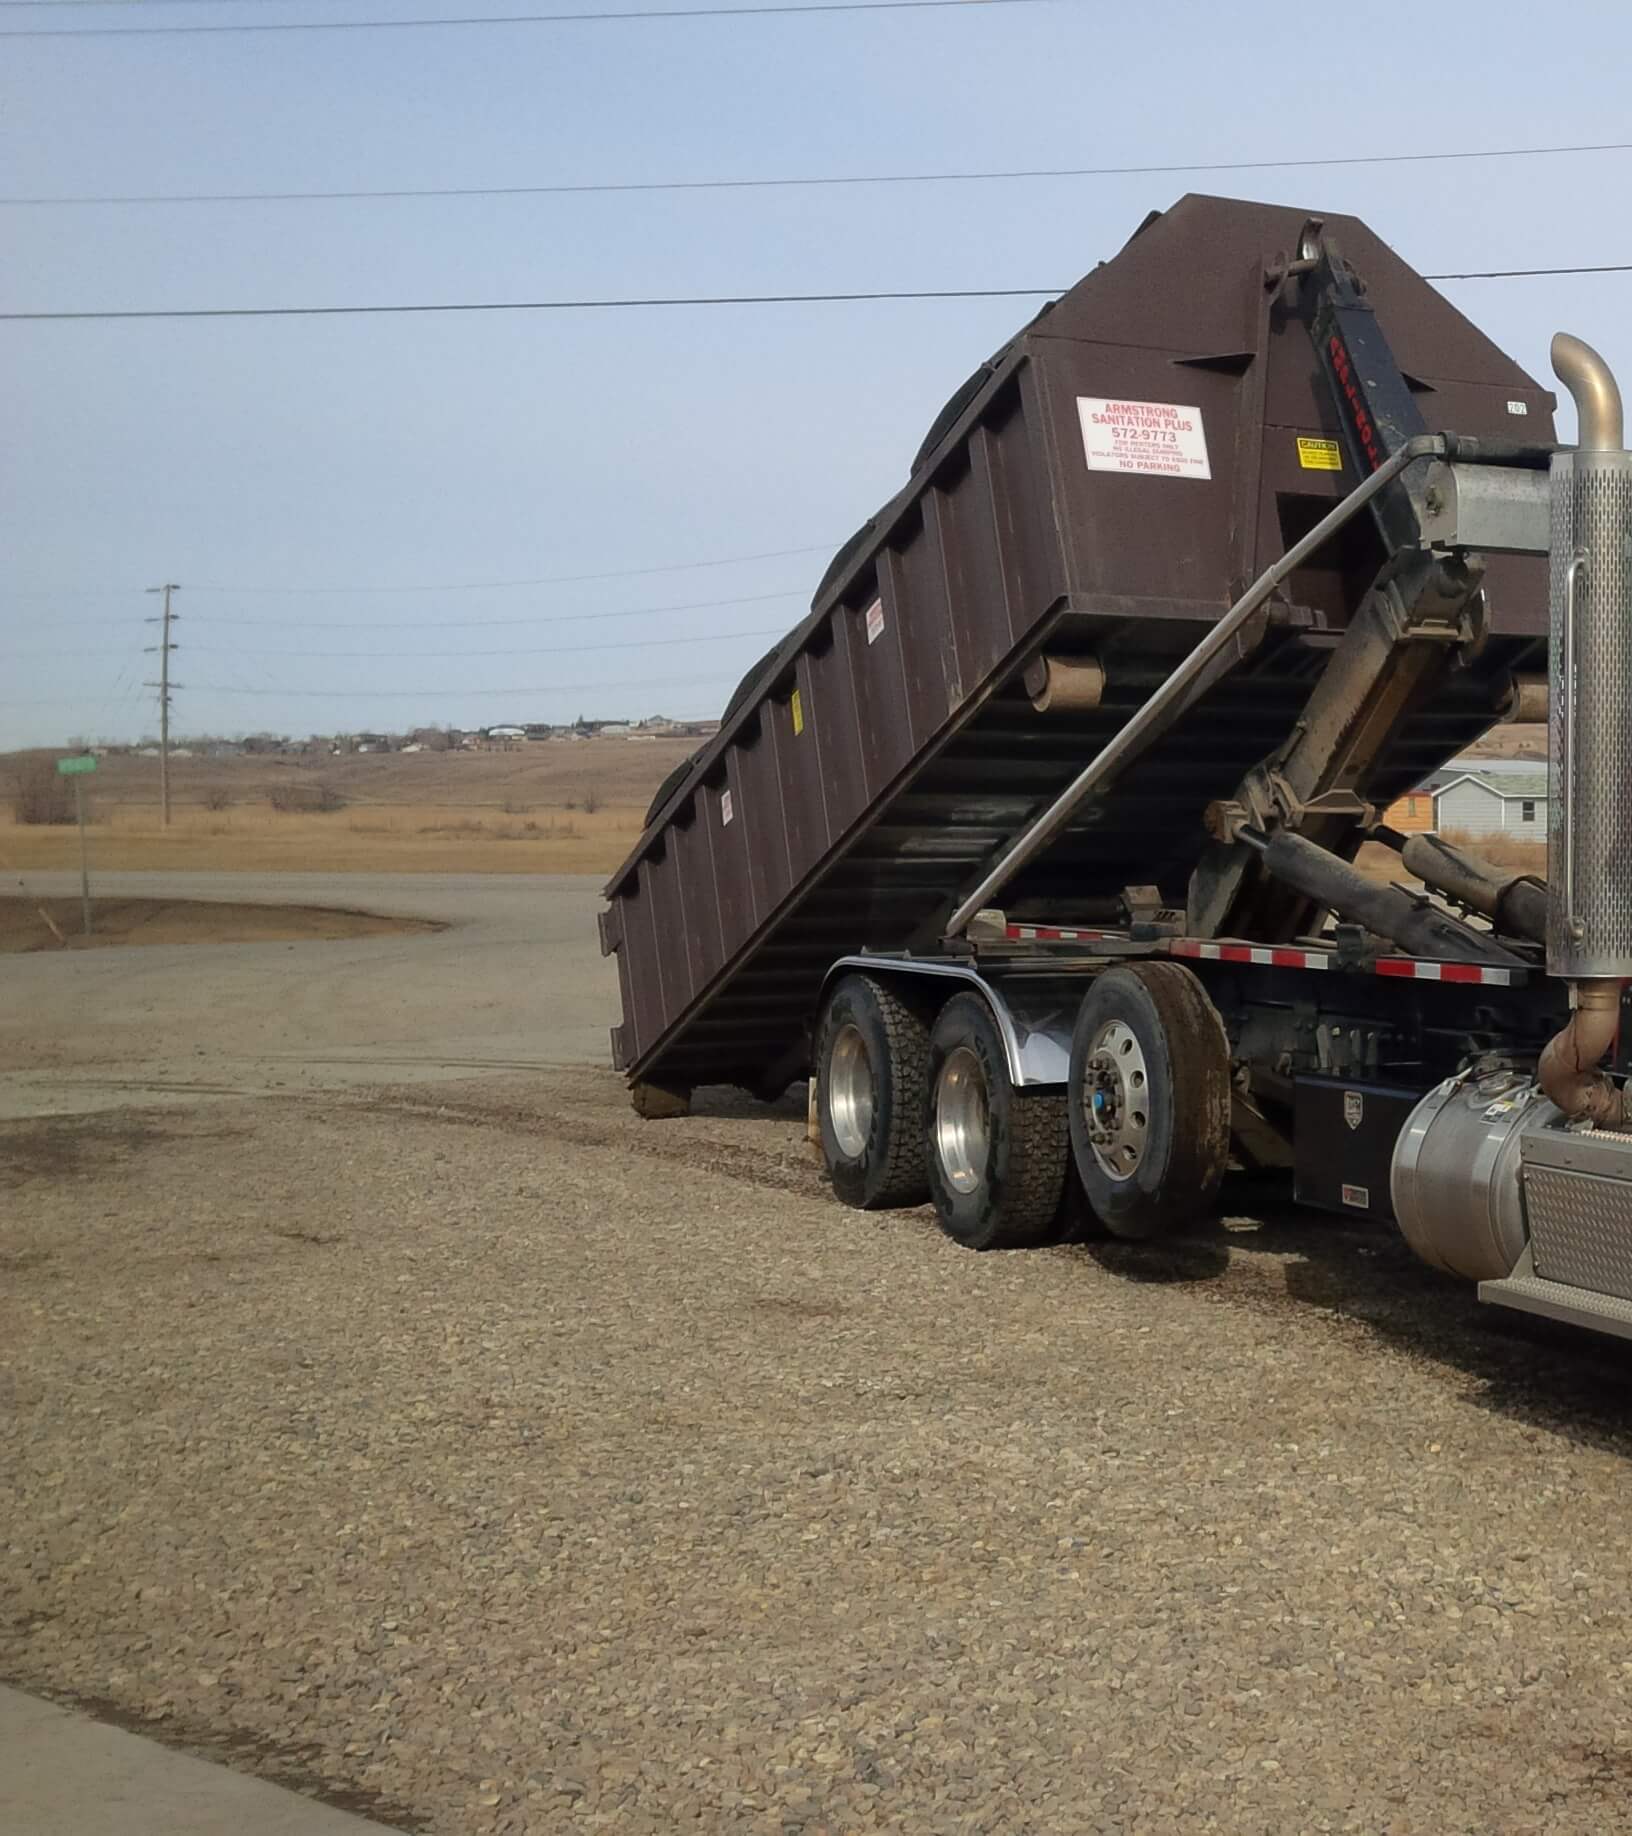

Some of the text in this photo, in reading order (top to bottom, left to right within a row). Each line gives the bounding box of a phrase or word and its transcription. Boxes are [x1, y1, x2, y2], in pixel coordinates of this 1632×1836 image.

[1105, 403, 1178, 419] ARMSTRONG
[1091, 413, 1193, 432] SANITATION PLUS
[1112, 427, 1176, 442] 572-9773
[1119, 460, 1181, 472] NO PARKING
